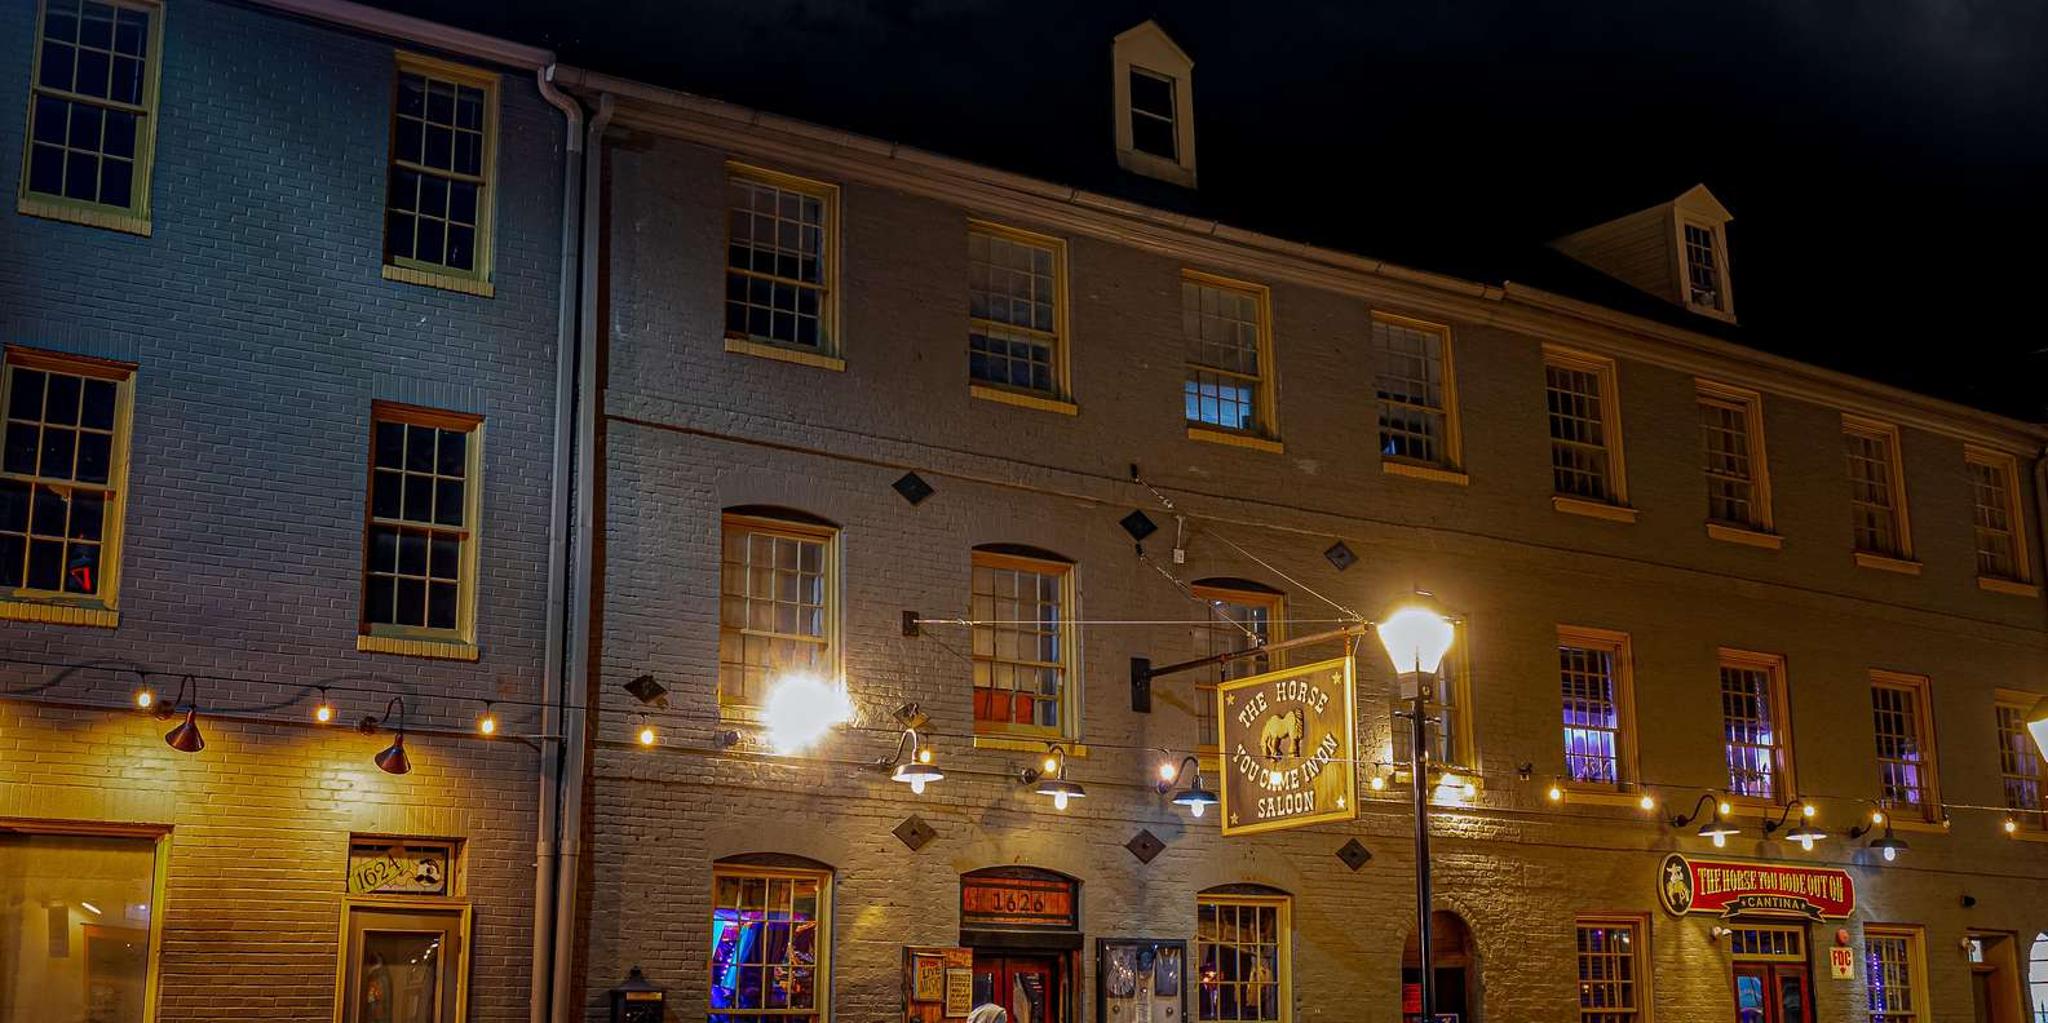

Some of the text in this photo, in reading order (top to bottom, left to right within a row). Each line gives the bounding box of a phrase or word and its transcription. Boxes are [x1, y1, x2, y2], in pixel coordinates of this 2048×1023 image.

[1239, 680, 1328, 728] THE HORSE
[1233, 743, 1259, 782] YOU
[1258, 790, 1315, 819] SALOON
[357, 854, 400, 890] 1624
[1697, 868, 1844, 903] THE HORSE YOU RODE OUT ON
[992, 893, 1044, 912] 1626
[1747, 897, 1799, 909] CANTINA
[1832, 950, 1851, 966] FDC
